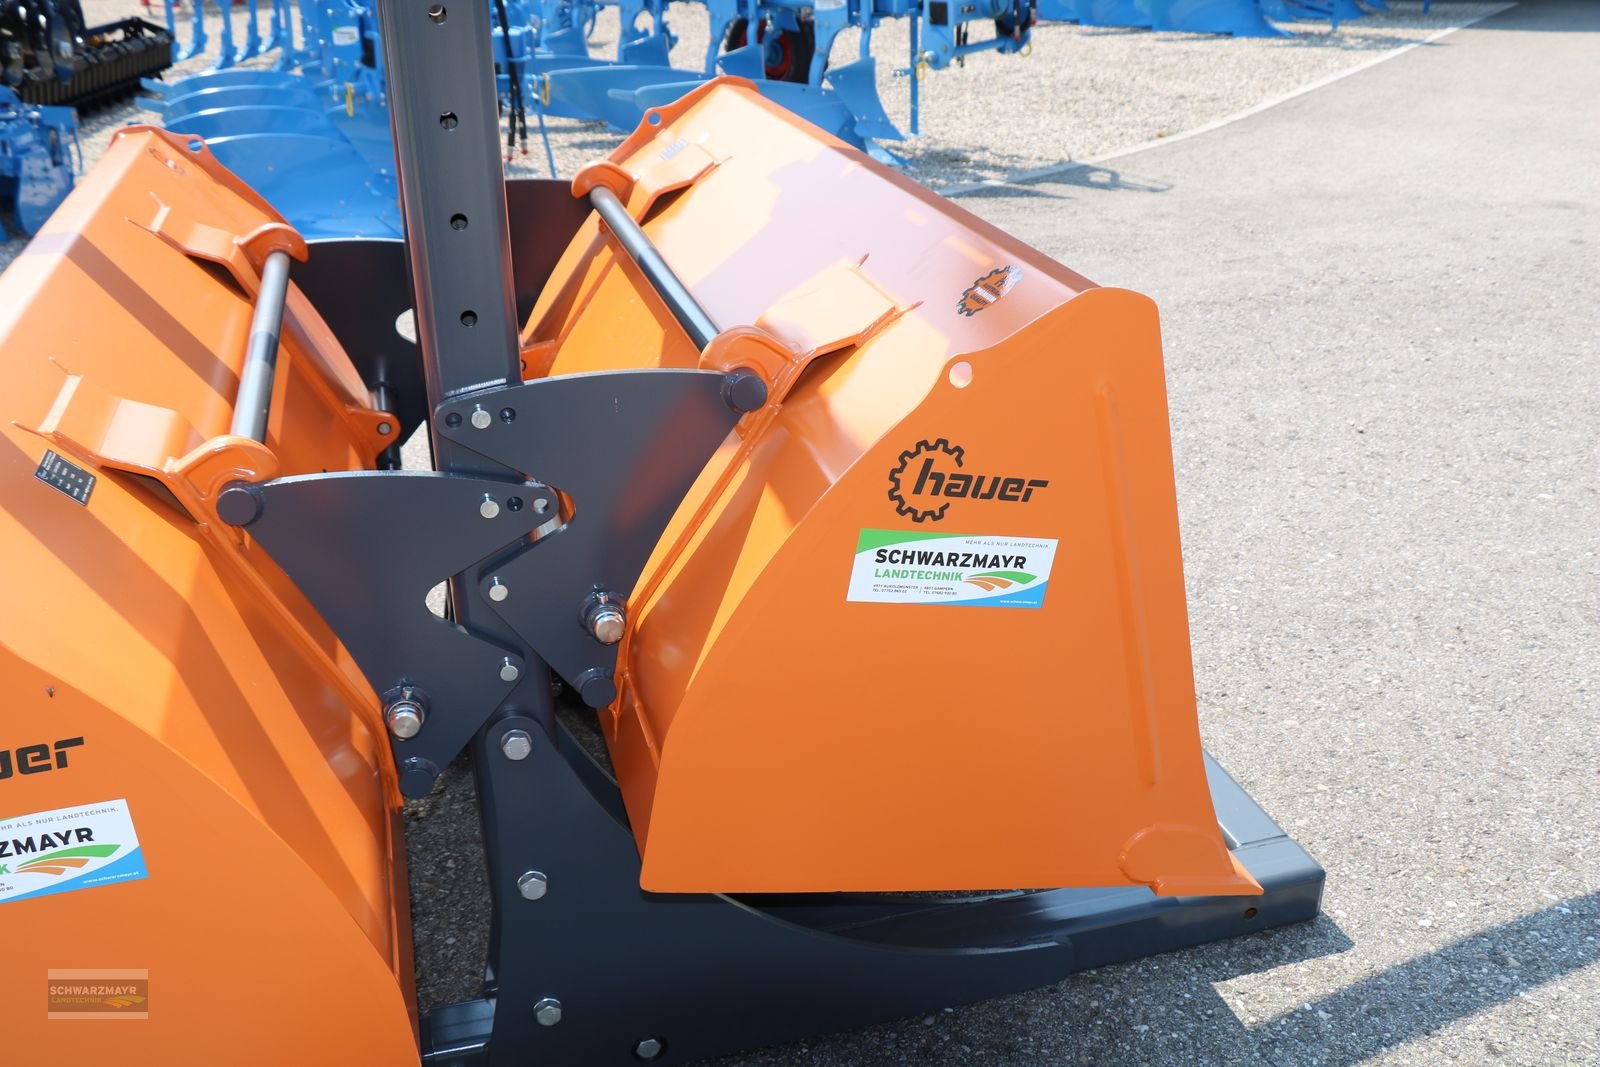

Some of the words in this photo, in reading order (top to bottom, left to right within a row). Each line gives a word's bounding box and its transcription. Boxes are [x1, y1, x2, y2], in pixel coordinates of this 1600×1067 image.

[912, 458, 1049, 503] hauer
[874, 548, 1027, 569] SCHWARZMAYR
[874, 568, 963, 582] LANDTECHNIK
[16, 820, 33, 828] ALS
[35, 817, 54, 825] NUR
